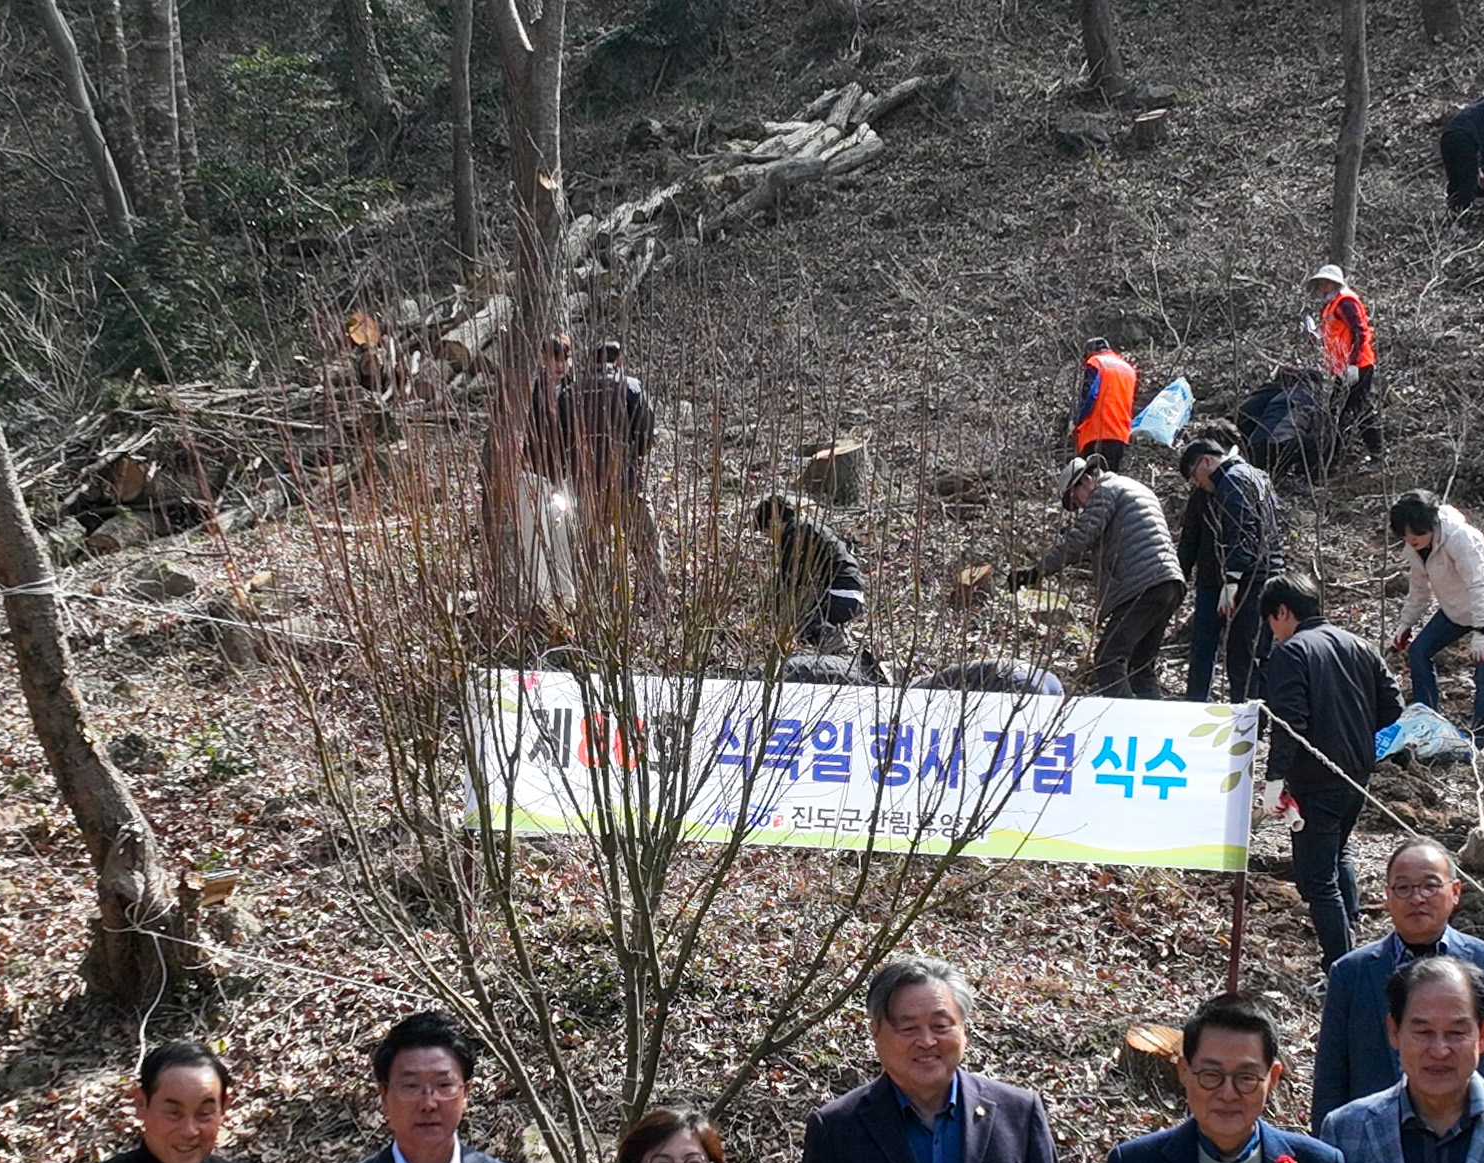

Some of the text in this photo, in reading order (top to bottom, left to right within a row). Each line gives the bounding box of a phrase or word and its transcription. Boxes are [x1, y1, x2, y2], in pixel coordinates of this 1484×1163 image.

[711, 717, 854, 783] 식목일
[869, 722, 966, 790] 행사
[978, 730, 1077, 796] 기념
[1091, 736, 1188, 801] 식수
